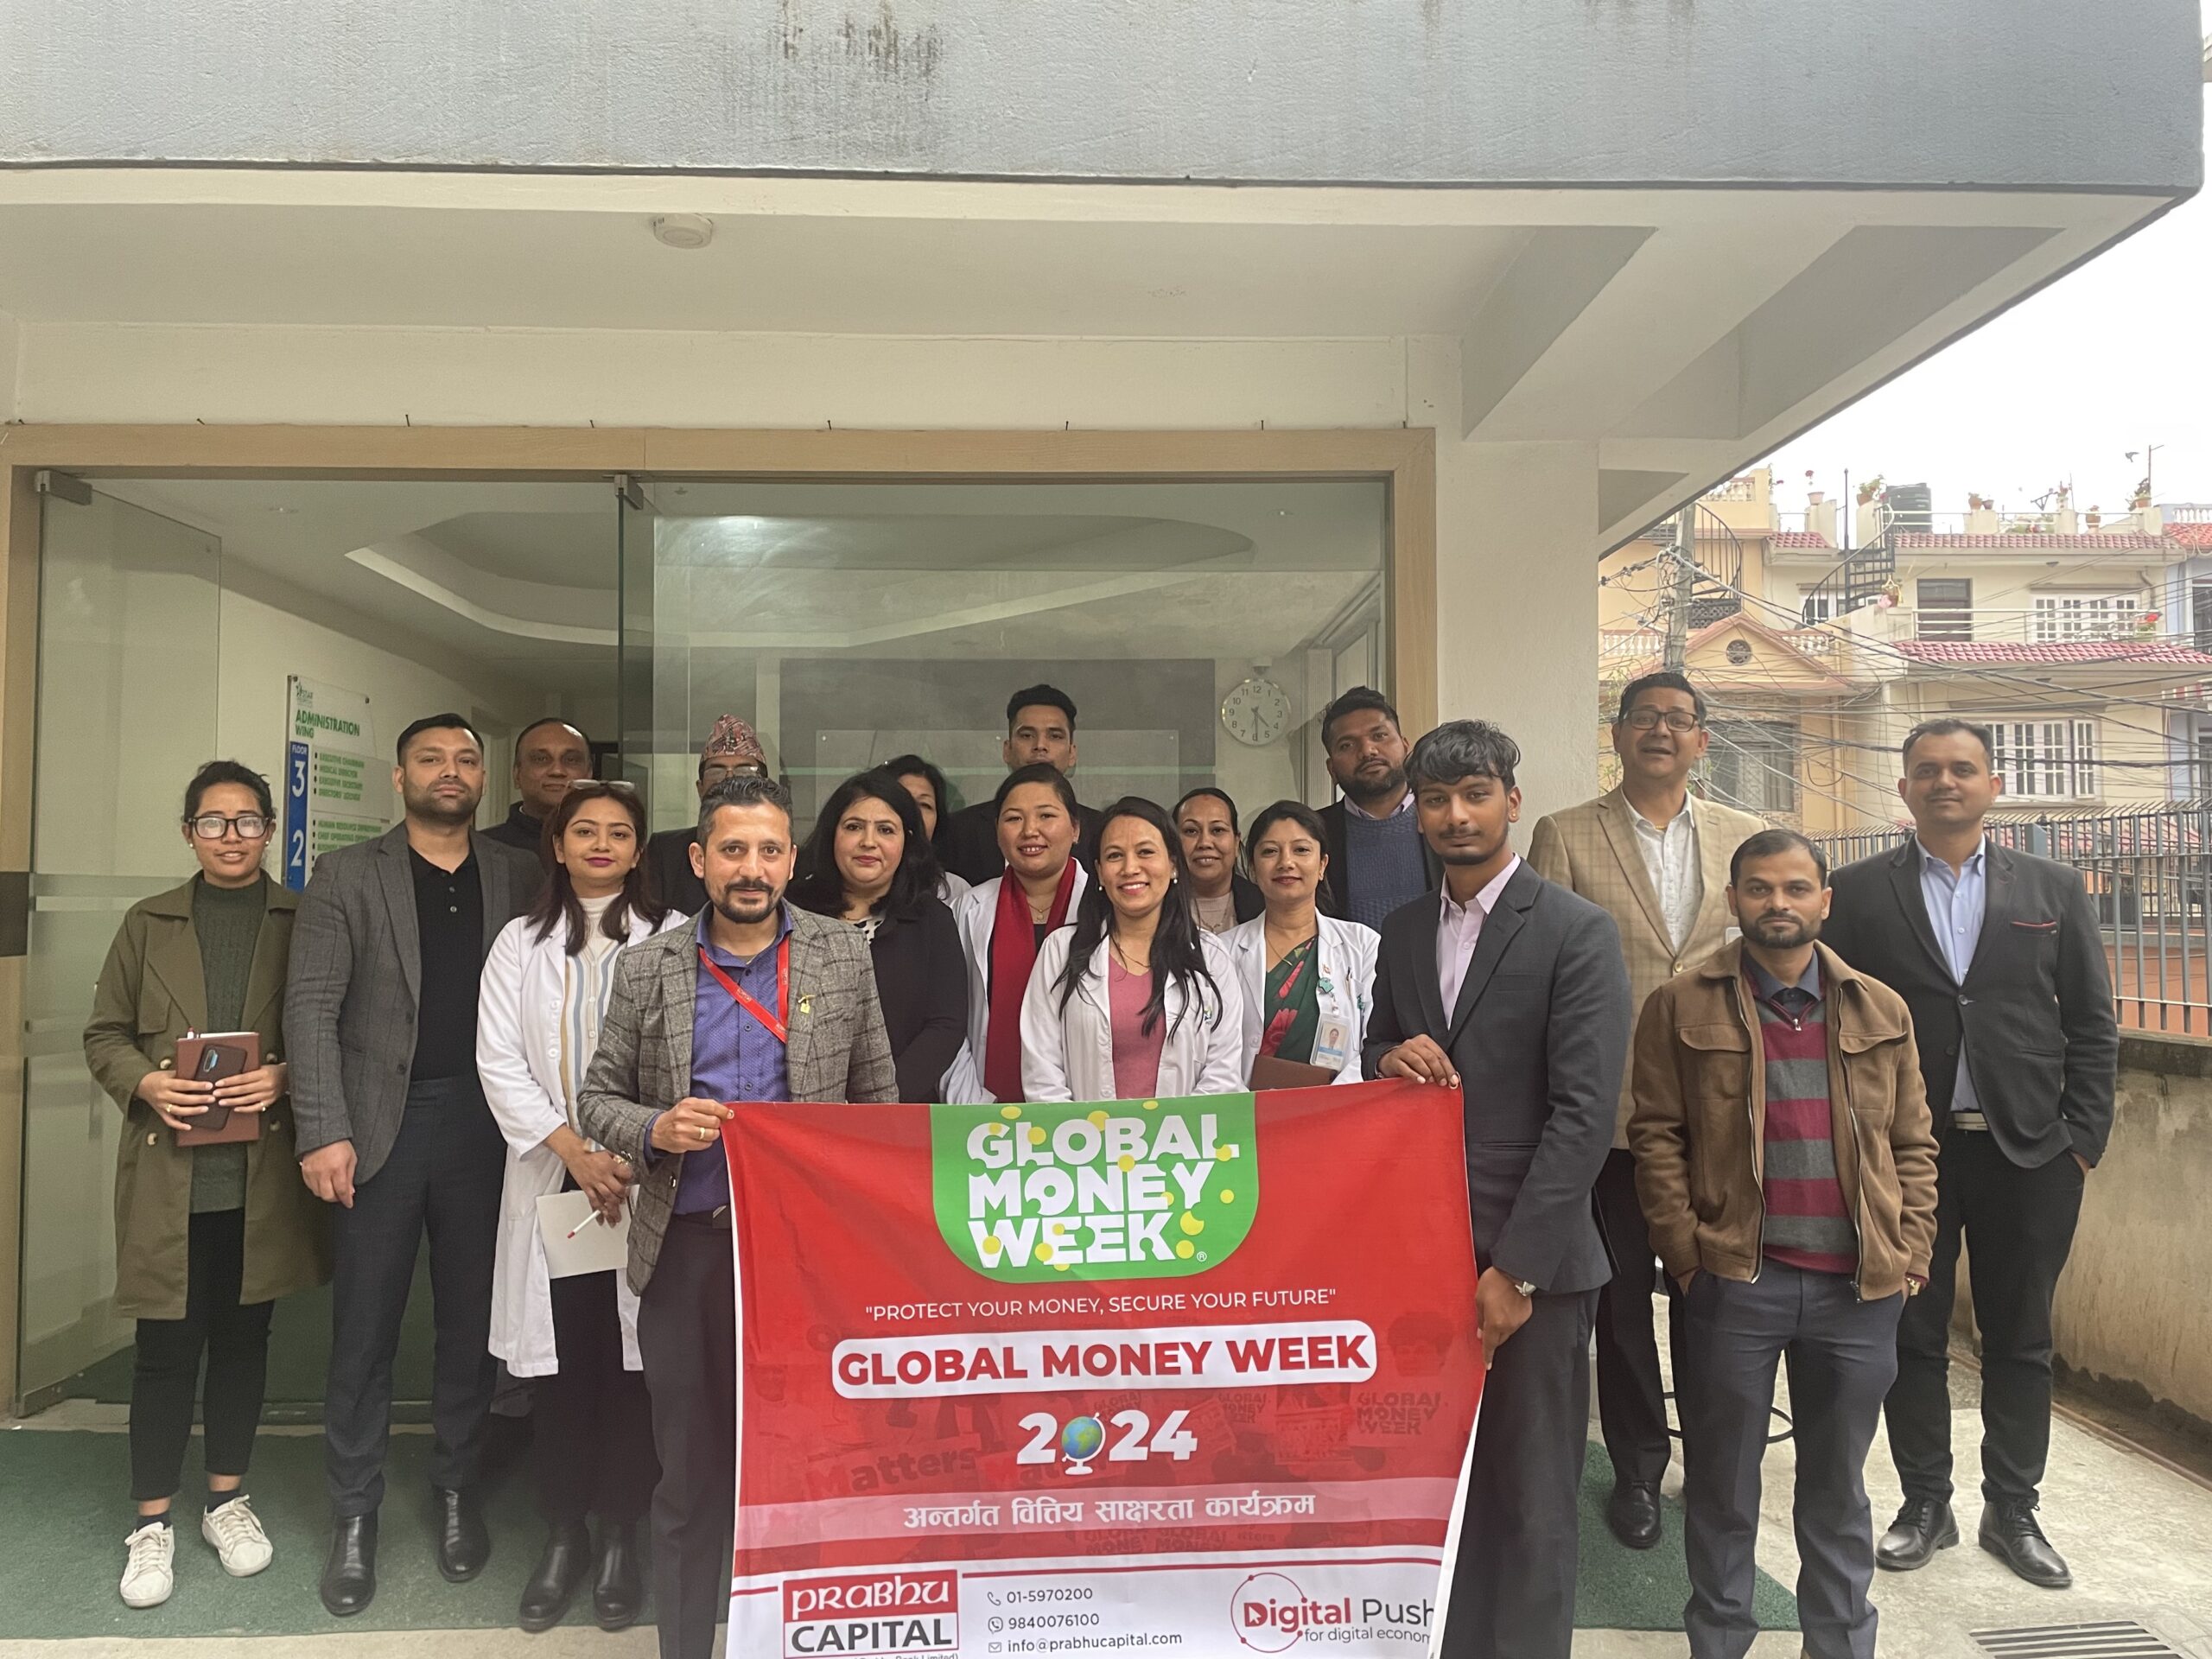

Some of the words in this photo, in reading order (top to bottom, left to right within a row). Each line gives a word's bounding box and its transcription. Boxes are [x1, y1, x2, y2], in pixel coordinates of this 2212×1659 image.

[1241, 688, 1249, 696] 11
[1253, 685, 1262, 694] 12
[1274, 698, 1281, 707] 2
[296, 709, 360, 737] ADMINISTRATION
[1277, 710, 1283, 719] 3
[295, 723, 315, 739] WING
[1264, 730, 1270, 739] 5
[292, 744, 308, 755] FLOOR
[291, 760, 306, 798] 3
[290, 829, 304, 868] 2
[966, 1114, 1240, 1169] GLOBAL
[968, 1161, 1215, 1219] MONEY
[968, 1212, 1176, 1269] WEEK
[865, 1302, 963, 1321] "PROTECT
[967, 1300, 1023, 1318] YOUR
[1028, 1297, 1104, 1315] MONEY,
[1109, 1294, 1186, 1313] SECURE
[1191, 1292, 1247, 1309] YOUR
[1252, 1288, 1337, 1307] FUTURE"
[838, 1346, 1028, 1386] GLOBAL
[1042, 1341, 1213, 1378] MONEY
[1225, 1335, 1371, 1374] WEEK
[1357, 1391, 1441, 1407] GLOBAL
[1356, 1406, 1438, 1421] MONEY
[903, 1500, 1001, 1529] अन्तर्गत
[1095, 1499, 1195, 1523] साक्षरता
[1205, 1490, 1316, 1517] कार्यक्रम
[1007, 1587, 1093, 1604] 01-5970200
[1008, 1613, 1100, 1630] 9840076100
[1243, 1597, 1351, 1633] Digital
[791, 1618, 953, 1653] CAPITAL
[1007, 1633, 1183, 1654] info@prabhucapital.com
[1305, 1628, 1323, 1642] for
[1327, 1626, 1373, 1643] digital
